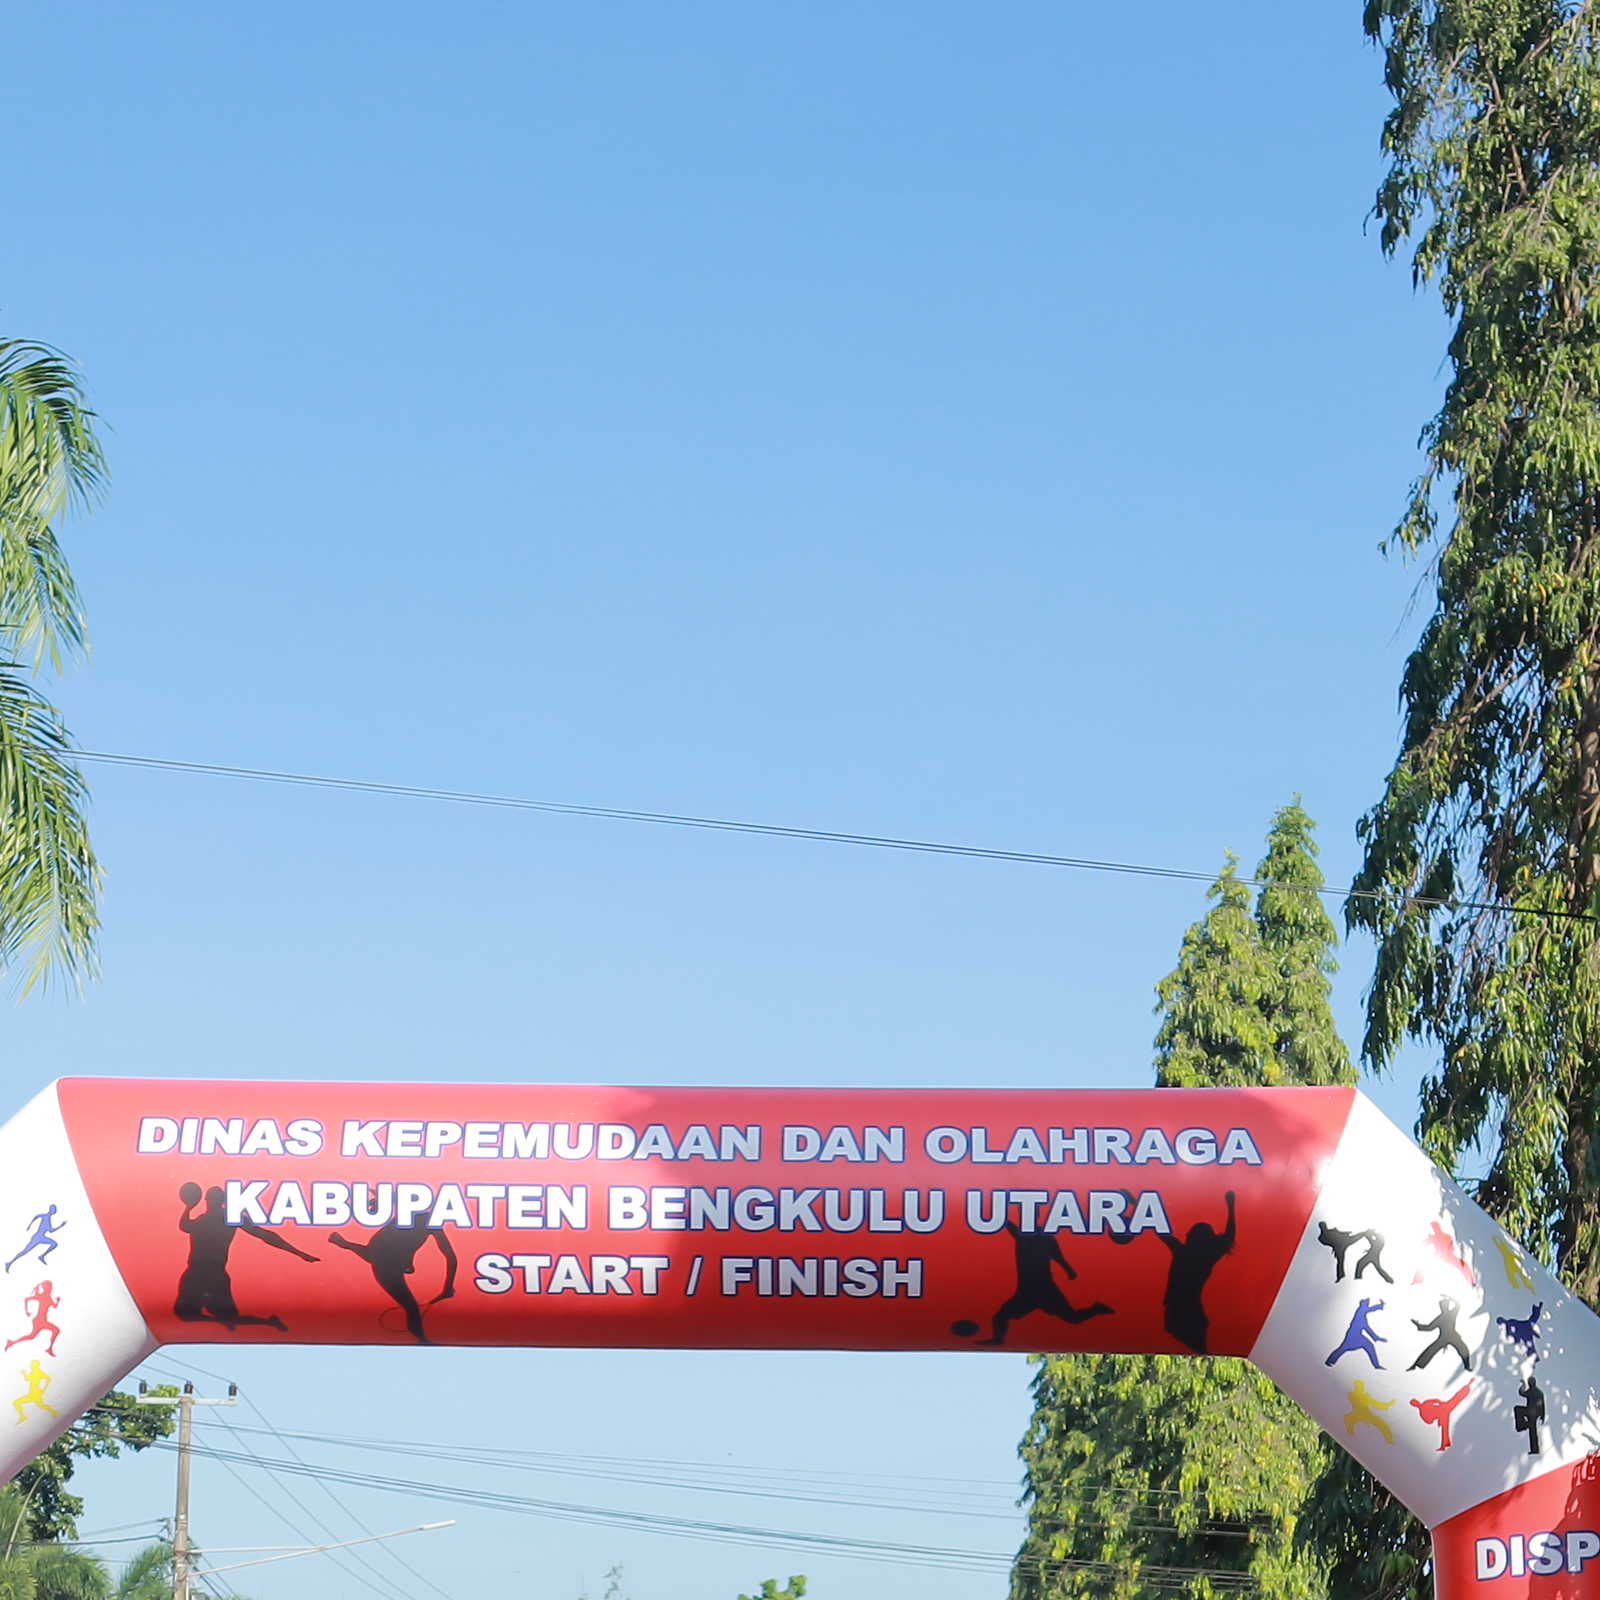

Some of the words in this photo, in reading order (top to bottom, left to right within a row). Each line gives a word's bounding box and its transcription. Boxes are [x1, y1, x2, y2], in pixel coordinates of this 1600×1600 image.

[138, 1116, 322, 1156] DINAS
[342, 1119, 760, 1162] KEPEMUDAAN
[782, 1124, 904, 1164] DAN
[924, 1126, 1262, 1165] OLAHRAGA
[225, 1180, 588, 1230] KABUPATEN
[608, 1186, 944, 1233] BENGKULU
[965, 1190, 1170, 1235] UTARA
[474, 1253, 669, 1297] START
[686, 1256, 703, 1296] /
[720, 1257, 925, 1298] FINISH
